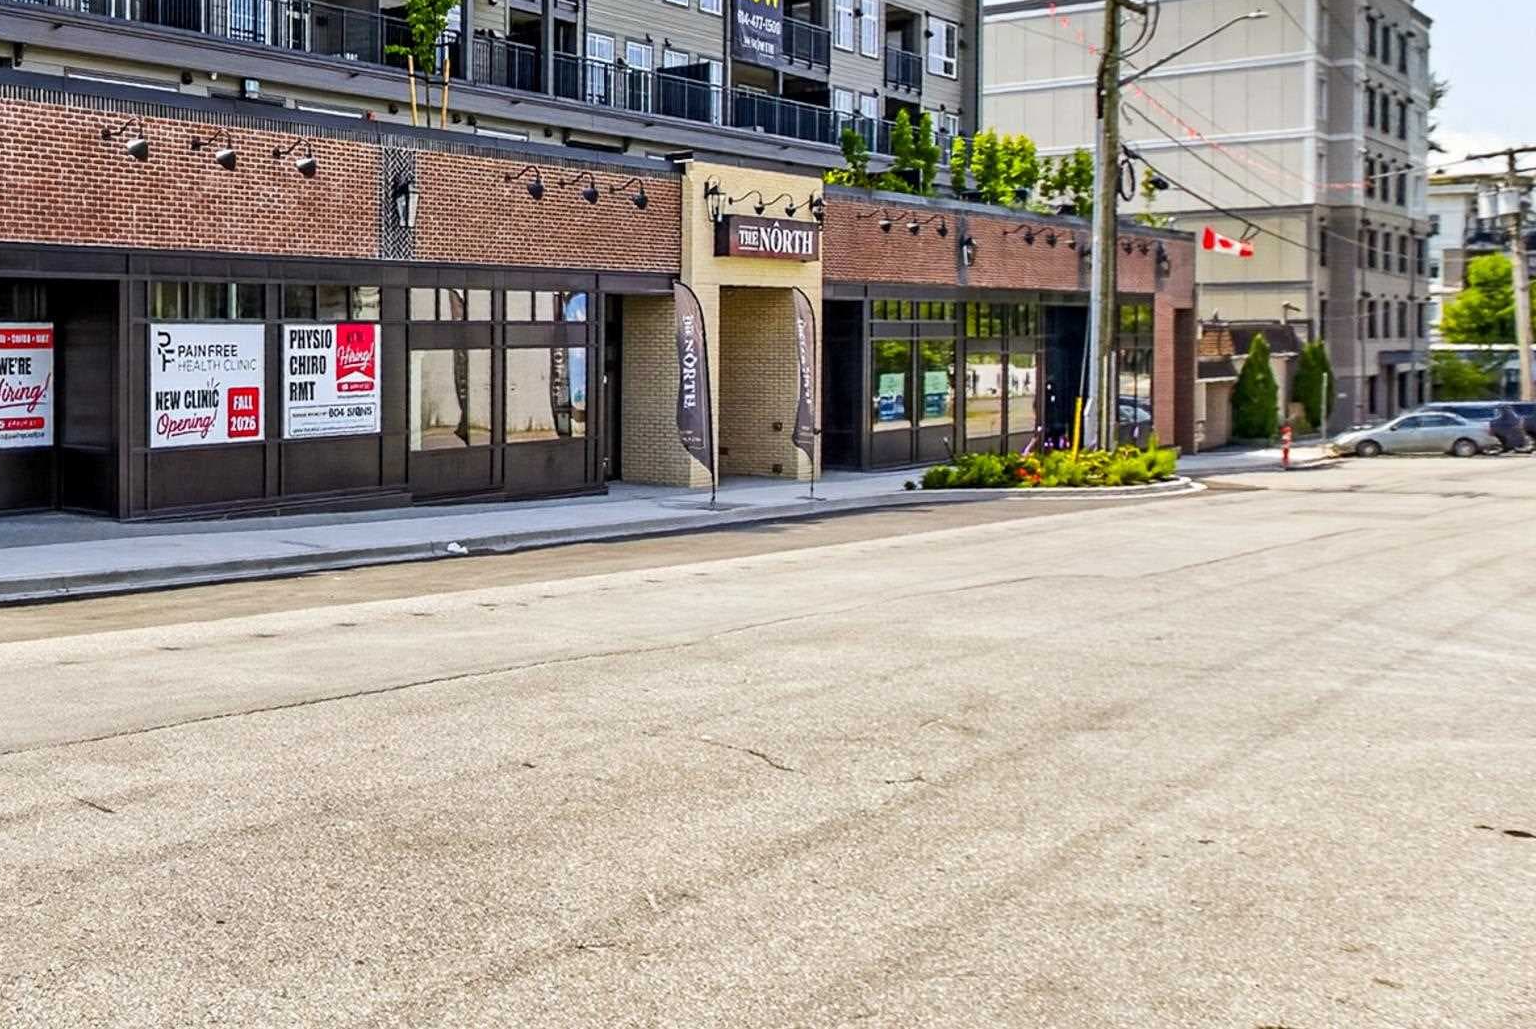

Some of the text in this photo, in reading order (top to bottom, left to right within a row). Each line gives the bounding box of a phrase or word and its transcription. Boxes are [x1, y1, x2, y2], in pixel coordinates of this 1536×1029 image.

[738, 230, 759, 246] THE
[289, 329, 332, 349] PHYSIO
[178, 358, 257, 372] HEALTH CLINIC
[289, 355, 326, 376] CHIRO
[155, 388, 220, 411] NEW CLINIC
[289, 380, 316, 401] RMT
[233, 395, 253, 411] FALL
[156, 409, 218, 440] Opening!
